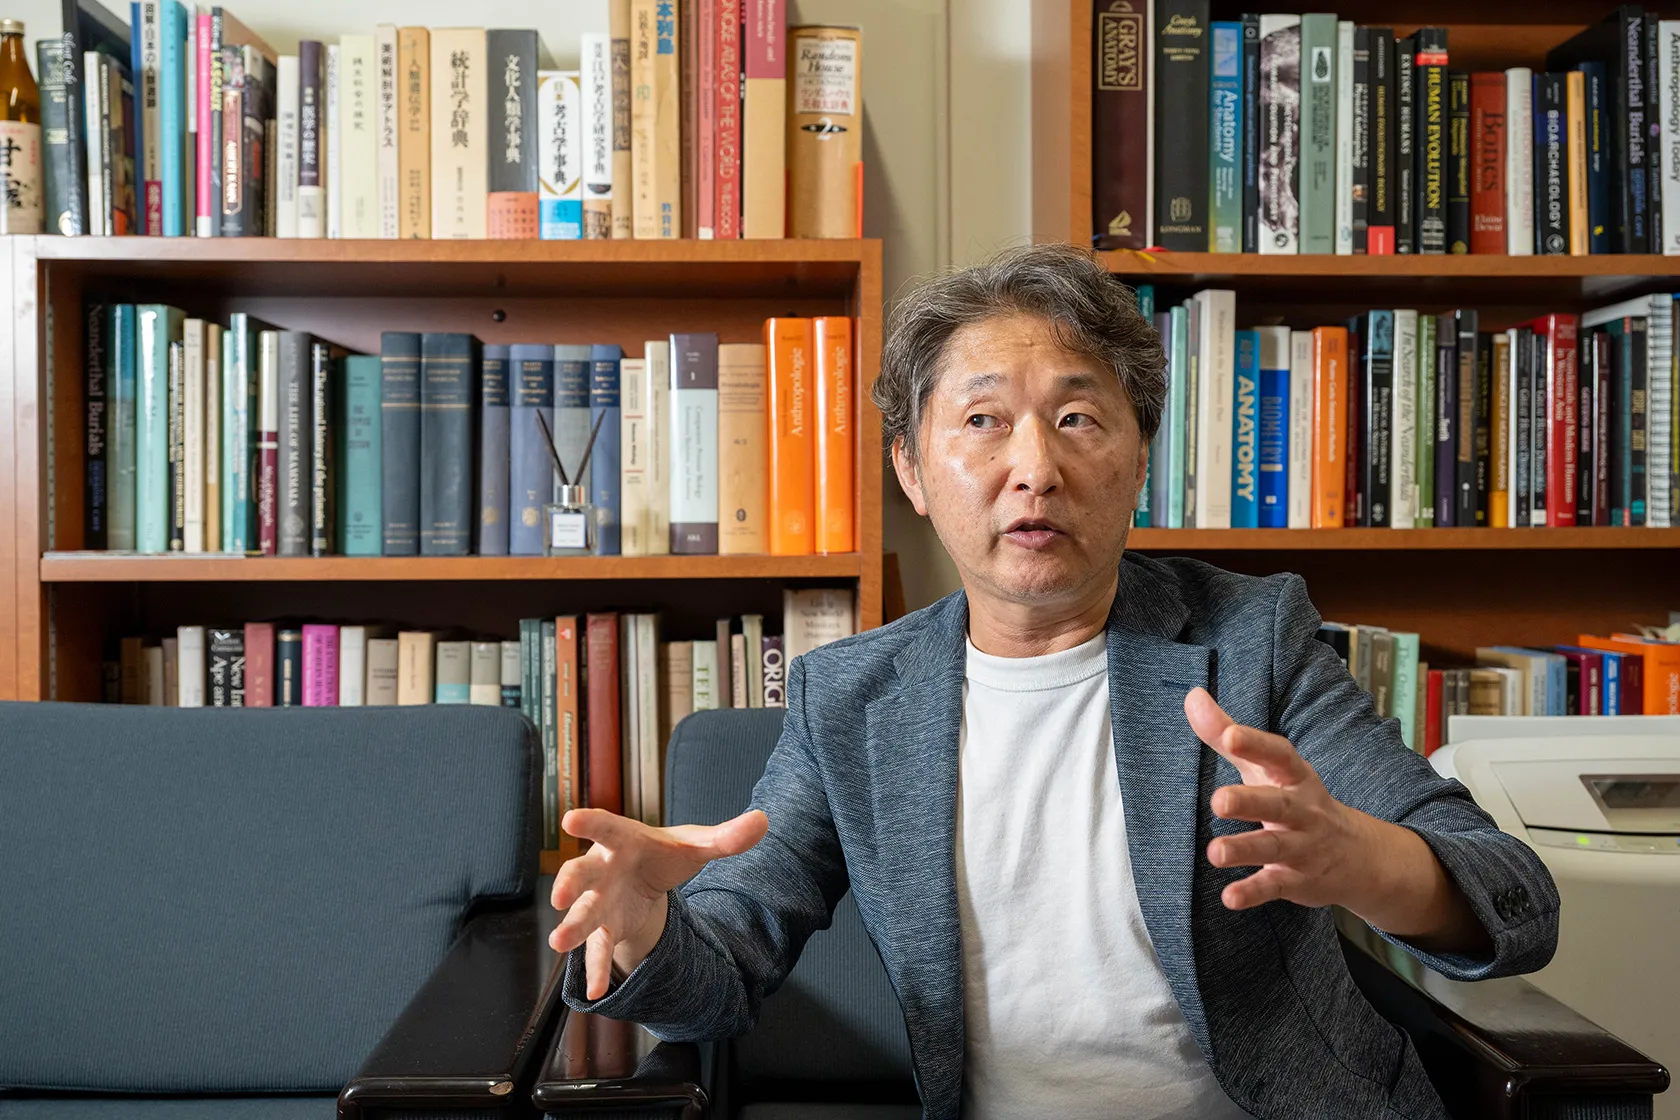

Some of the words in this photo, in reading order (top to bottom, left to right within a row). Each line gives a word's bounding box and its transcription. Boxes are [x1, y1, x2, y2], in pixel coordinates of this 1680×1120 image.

[719, 45, 735, 81] ATLAS
[801, 49, 852, 62] Random
[808, 60, 843, 73] House
[1104, 19, 1118, 86] ANATOMY
[1118, 20, 1137, 86] GRAY'S
[1401, 53, 1412, 102] EXTINCT
[1627, 16, 1644, 107] Neanderthal
[211, 52, 222, 111] LASCAUX
[450, 49, 469, 148] 統計学辞典
[719, 82, 735, 102] OF
[1427, 67, 1441, 122] HUMAN
[1669, 32, 1680, 135] Anthropology
[504, 54, 522, 164] 文化人類学事典
[719, 104, 735, 129] THE
[817, 116, 832, 141] 2
[1220, 90, 1238, 163] Anatomy
[1401, 106, 1412, 155] HUMANS
[719, 130, 735, 179] WORLD
[1482, 112, 1504, 191] Bones
[1628, 112, 1644, 164] Burials
[1671, 139, 1680, 182] Today
[1427, 124, 1441, 209] EVOLUTION
[1546, 109, 1561, 230] BIOARCHAEOLOGY
[1160, 225, 1201, 233] LONGMAN
[87, 303, 102, 396] Neanderthal
[1402, 331, 1416, 344] In
[317, 370, 327, 389] The
[789, 347, 805, 437] Anthropologie
[833, 346, 848, 436] Anthropologie
[1401, 348, 1415, 388] Search
[1399, 388, 1414, 403] of
[1401, 403, 1415, 421] the
[1555, 399, 1566, 421] Asia
[1564, 407, 1575, 423] and
[87, 400, 103, 455] Burials
[1237, 375, 1255, 502] ANATOMY
[1261, 396, 1283, 463] BIOMETRY
[1563, 424, 1575, 463] Modern
[288, 451, 299, 508] MAMMALS
[1399, 425, 1414, 501] Neanderthals
[1562, 464, 1574, 503] Humans
[210, 655, 229, 685] Ape
[230, 656, 245, 688] New
[763, 648, 784, 708] ORIGI
[561, 711, 573, 777] Anthropology
